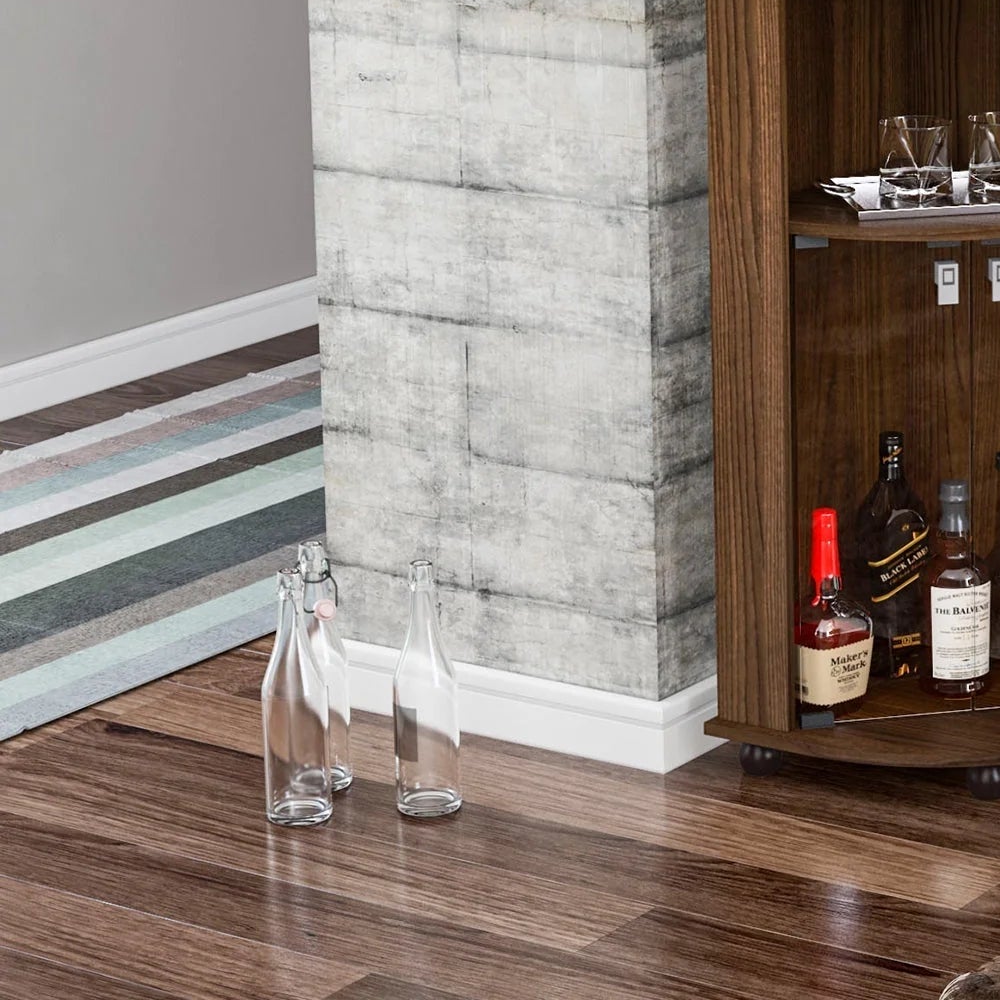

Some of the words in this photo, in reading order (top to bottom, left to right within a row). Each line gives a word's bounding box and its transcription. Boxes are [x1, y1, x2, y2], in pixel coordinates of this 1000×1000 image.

[880, 561, 907, 583] BLACK
[935, 607, 950, 615] THE
[831, 650, 868, 666] Maker's
[842, 660, 866, 674] Mark
